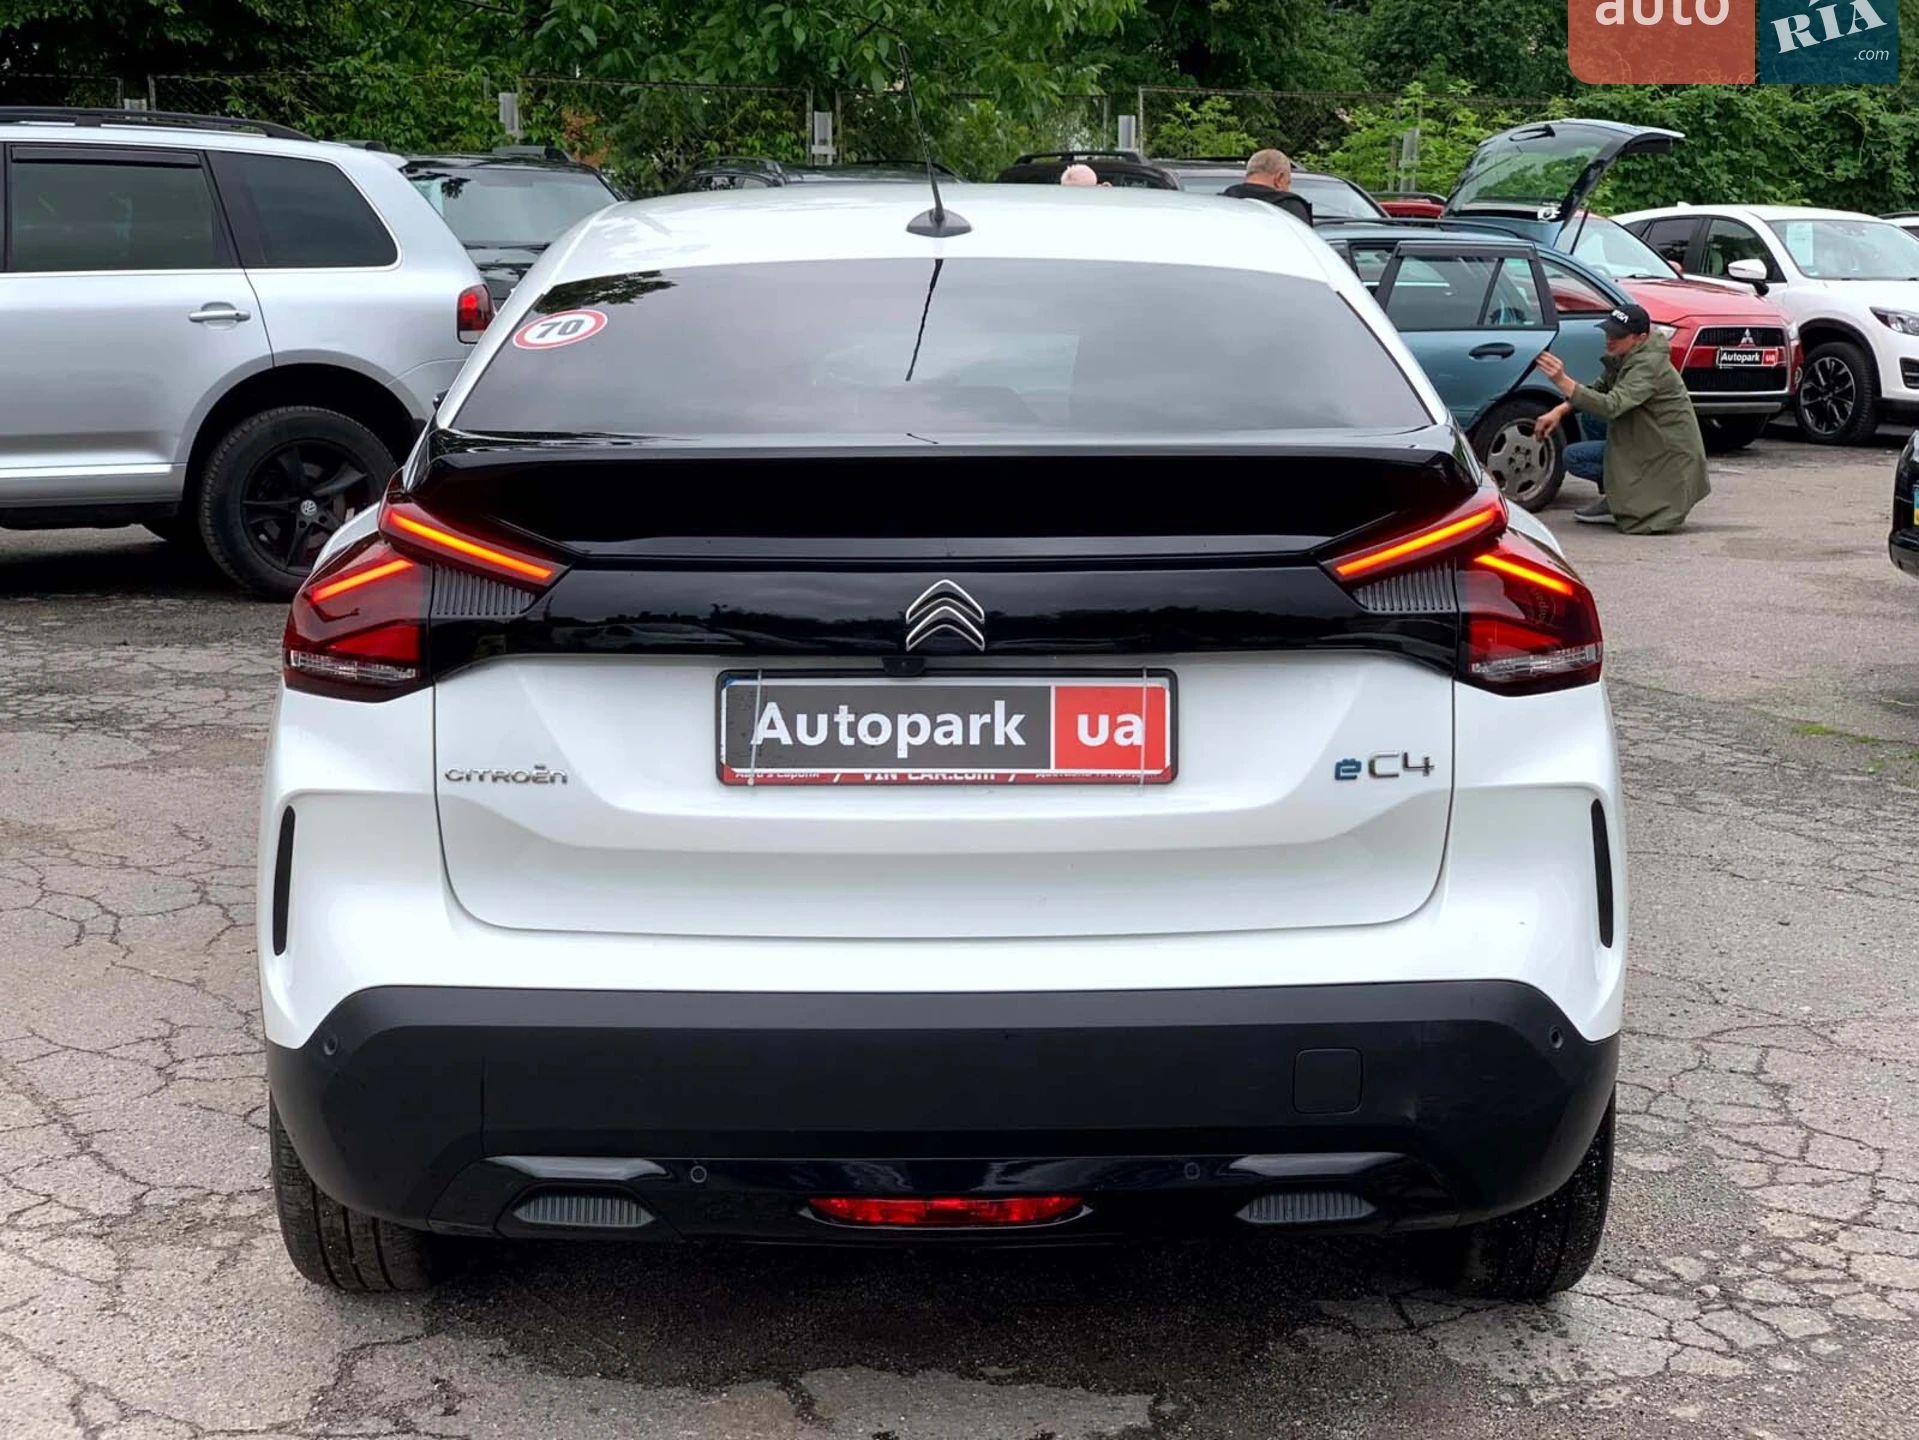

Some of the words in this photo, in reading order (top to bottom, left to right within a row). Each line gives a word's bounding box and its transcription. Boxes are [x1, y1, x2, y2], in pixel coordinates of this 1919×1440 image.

[536, 319, 585, 339] 70
[1720, 351, 1760, 364] Autopark
[1765, 354, 1776, 362] ua
[750, 700, 1027, 759] Autopark
[1077, 713, 1145, 747] ua
